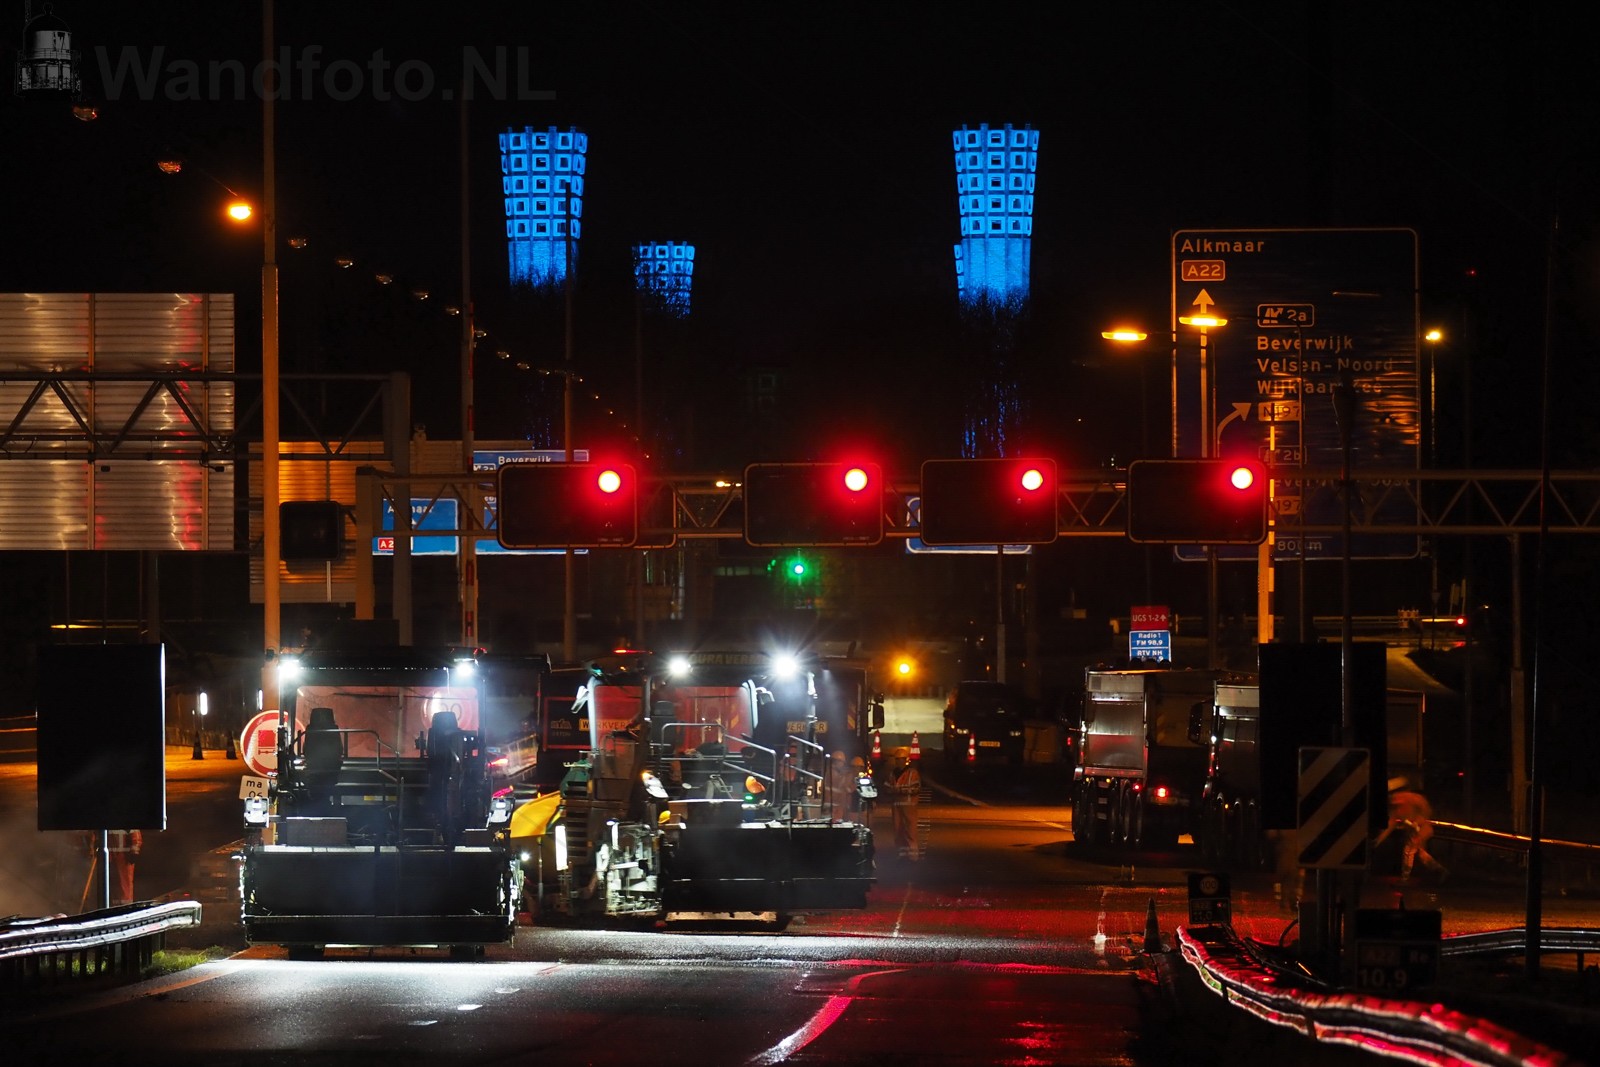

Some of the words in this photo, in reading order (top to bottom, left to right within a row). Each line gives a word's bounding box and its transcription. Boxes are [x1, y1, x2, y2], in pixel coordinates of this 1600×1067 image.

[1181, 238, 1265, 253] Alkmaar
[1187, 264, 1221, 277] A22
[1287, 309, 1307, 322] 2a
[1257, 336, 1353, 354] Beverwijk
[1132, 614, 1146, 622] UGS
[246, 780, 263, 788] ma
